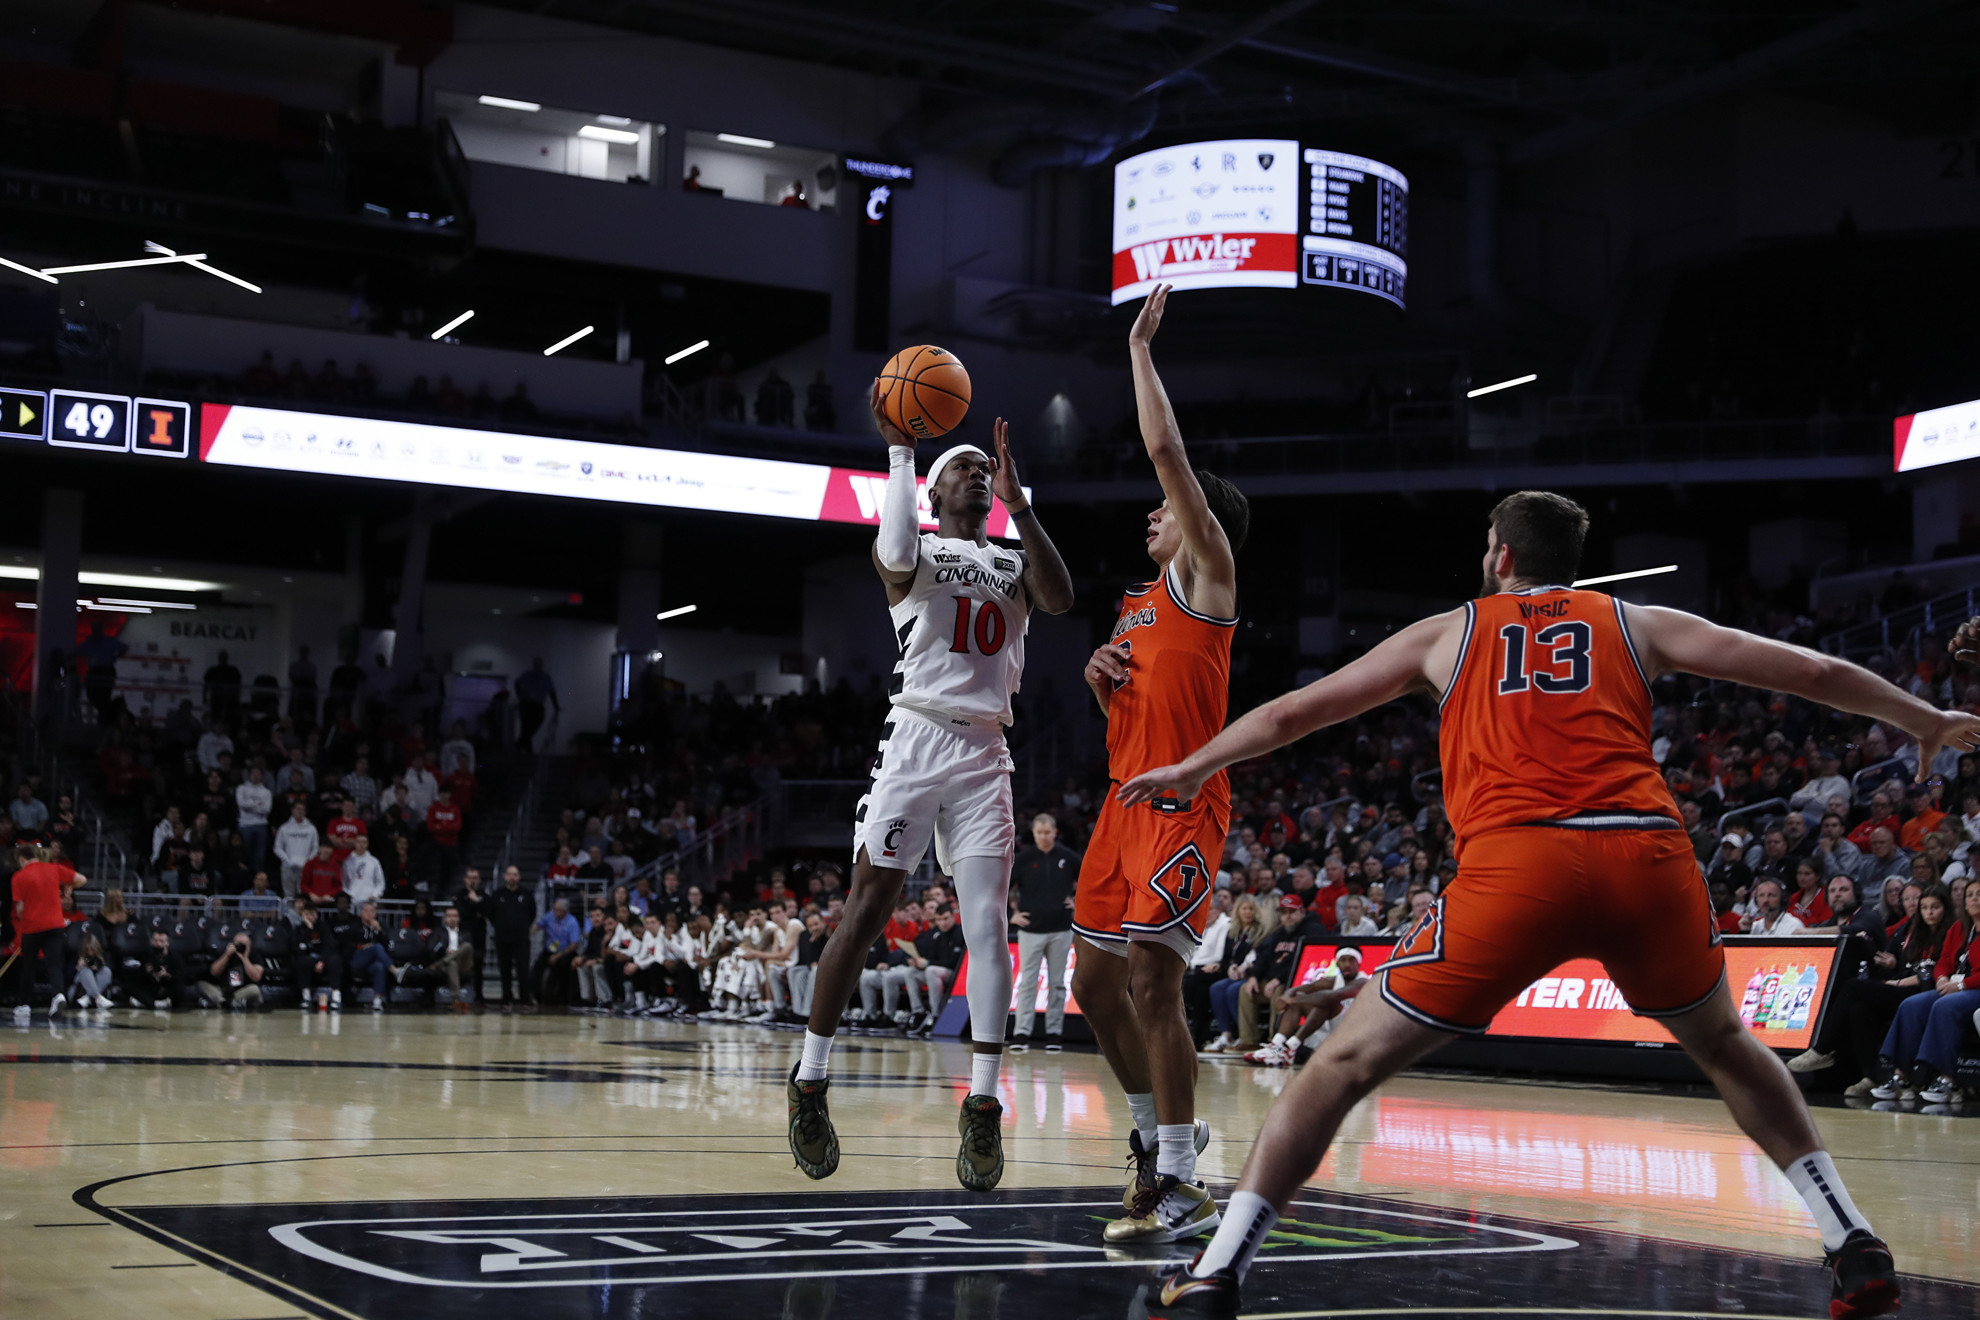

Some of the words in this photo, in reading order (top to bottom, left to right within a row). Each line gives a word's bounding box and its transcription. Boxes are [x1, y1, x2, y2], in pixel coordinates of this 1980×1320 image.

[61, 187, 185, 220] INCLINE
[1171, 232, 1257, 263] Wyler
[64, 402, 115, 439] 49
[148, 410, 174, 446] I
[935, 566, 1018, 600] CINCINNATI
[170, 621, 257, 641] BEARCAT
[949, 596, 1006, 656] 10
[1498, 620, 1592, 696] 13
